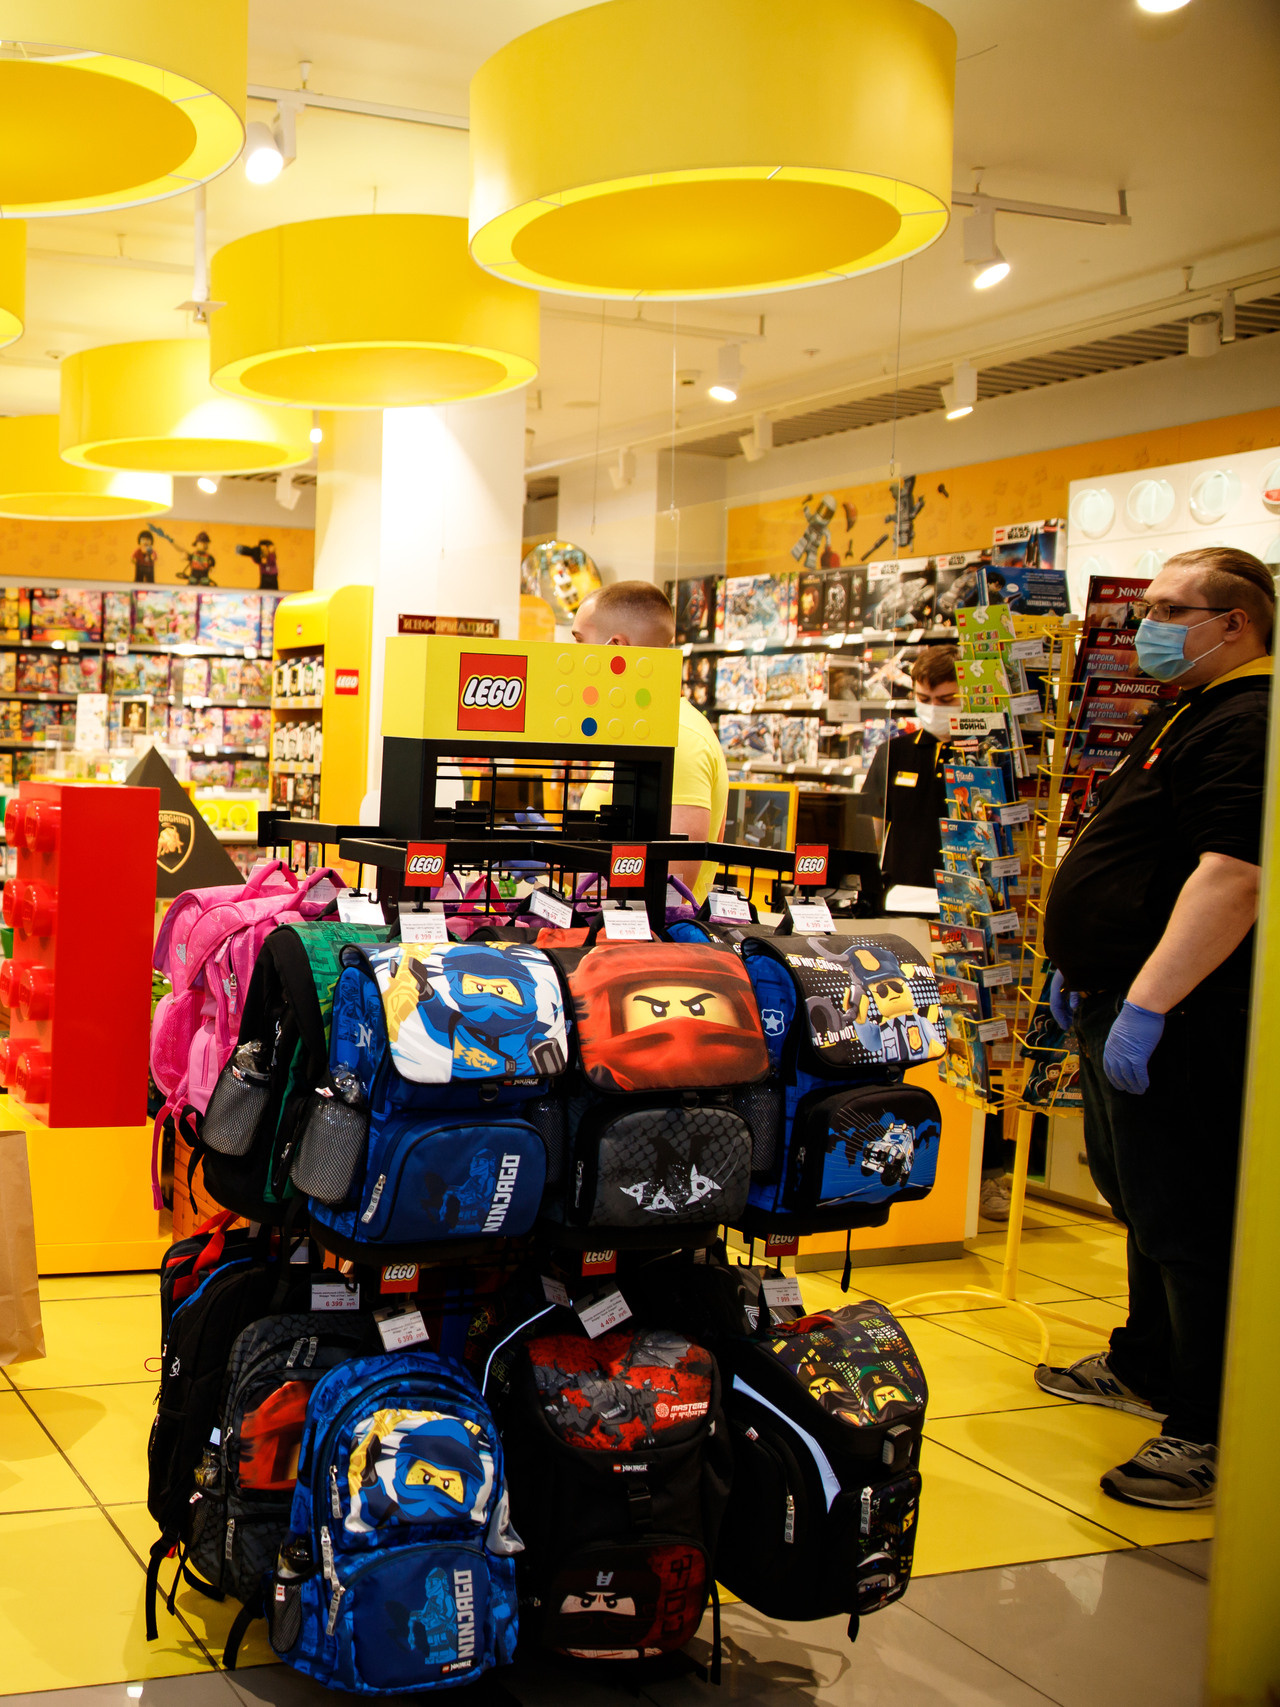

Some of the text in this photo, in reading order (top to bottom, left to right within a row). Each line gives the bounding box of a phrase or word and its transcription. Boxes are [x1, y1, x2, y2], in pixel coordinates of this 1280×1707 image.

[402, 617, 494, 634] ИНФОРМАЦИЯ
[336, 675, 358, 688] LEGO
[462, 676, 523, 708] LEGO
[159, 813, 189, 826] ORGHINI
[408, 856, 442, 873] LEGO
[613, 858, 643, 874] LEGO
[797, 857, 825, 873] LEGO
[800, 956, 816, 968] NOT
[839, 1025, 856, 1041] NOT
[481, 1154, 521, 1232] NINJAGO
[384, 1264, 417, 1281] LEGO
[605, 1315, 616, 1325] 499
[402, 1334, 413, 1342] 399
[670, 1401, 709, 1412] MASTERS
[453, 1569, 475, 1659] NINJAGO
